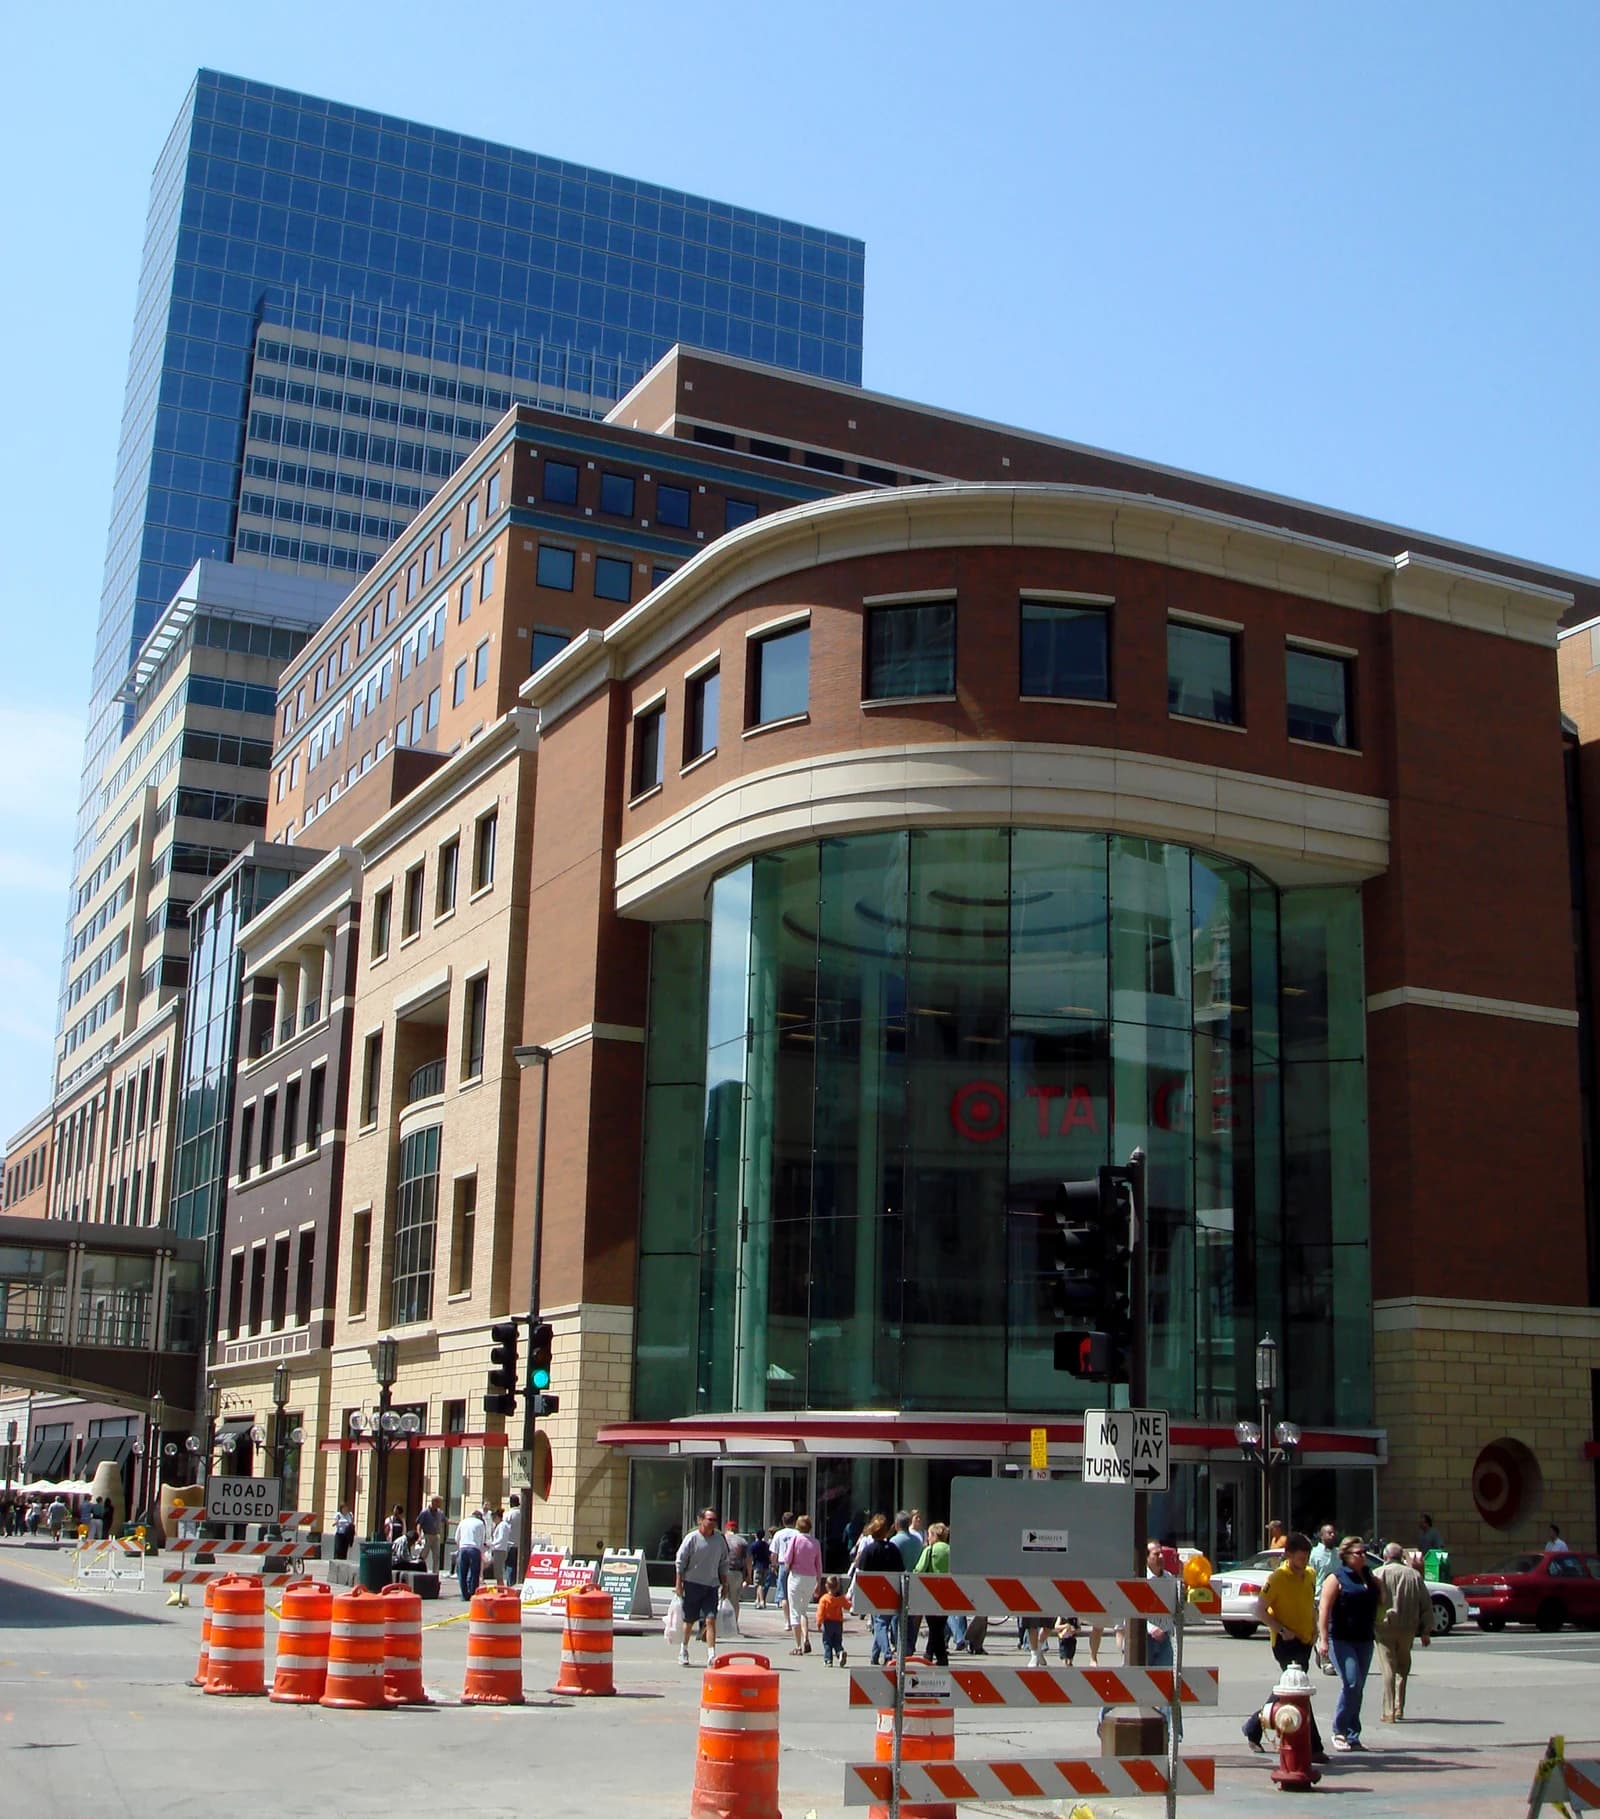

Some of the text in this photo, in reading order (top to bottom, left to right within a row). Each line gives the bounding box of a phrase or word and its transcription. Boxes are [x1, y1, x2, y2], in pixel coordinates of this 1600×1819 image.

[1100, 1423, 1119, 1446] NO
[517, 1455, 528, 1467] NO
[1086, 1458, 1131, 1478] TURNS
[222, 1483, 266, 1498] ROAD
[211, 1501, 274, 1517] CLOSED
